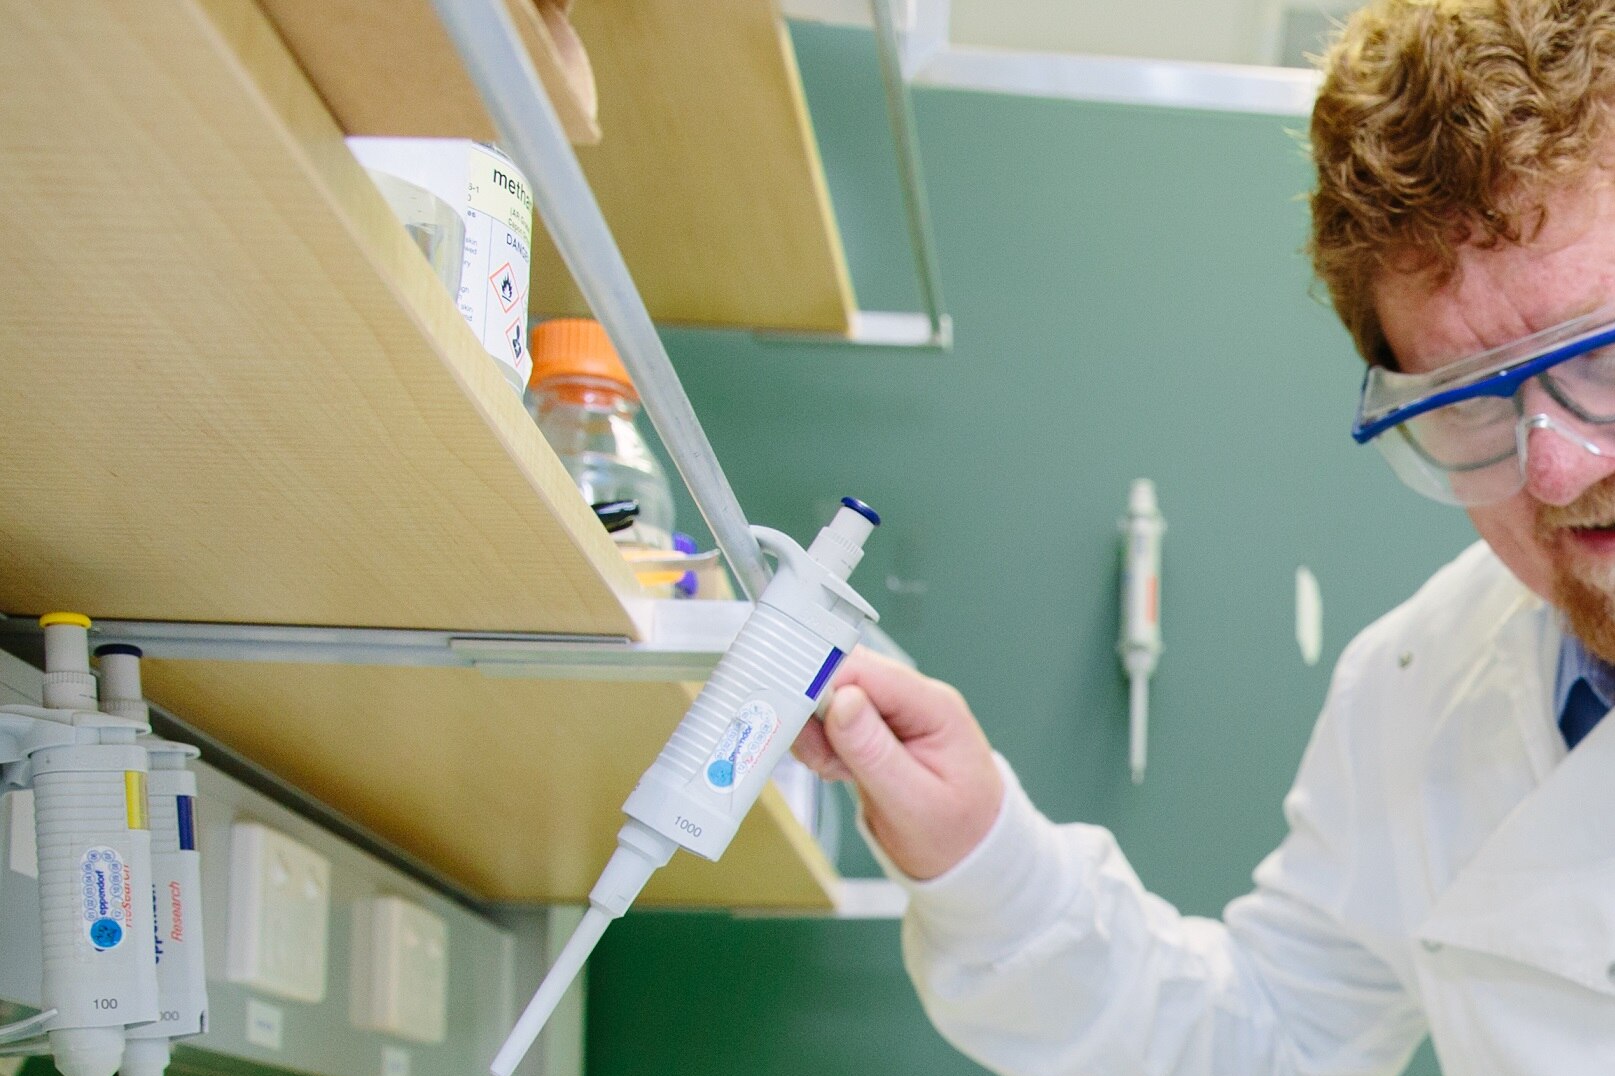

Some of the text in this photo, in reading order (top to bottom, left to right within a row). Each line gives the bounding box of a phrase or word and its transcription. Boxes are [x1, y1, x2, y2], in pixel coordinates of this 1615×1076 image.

[674, 815, 702, 838] 1000
[95, 870, 108, 916] eppendorf
[169, 881, 183, 942] Research
[94, 998, 118, 1010] 100
